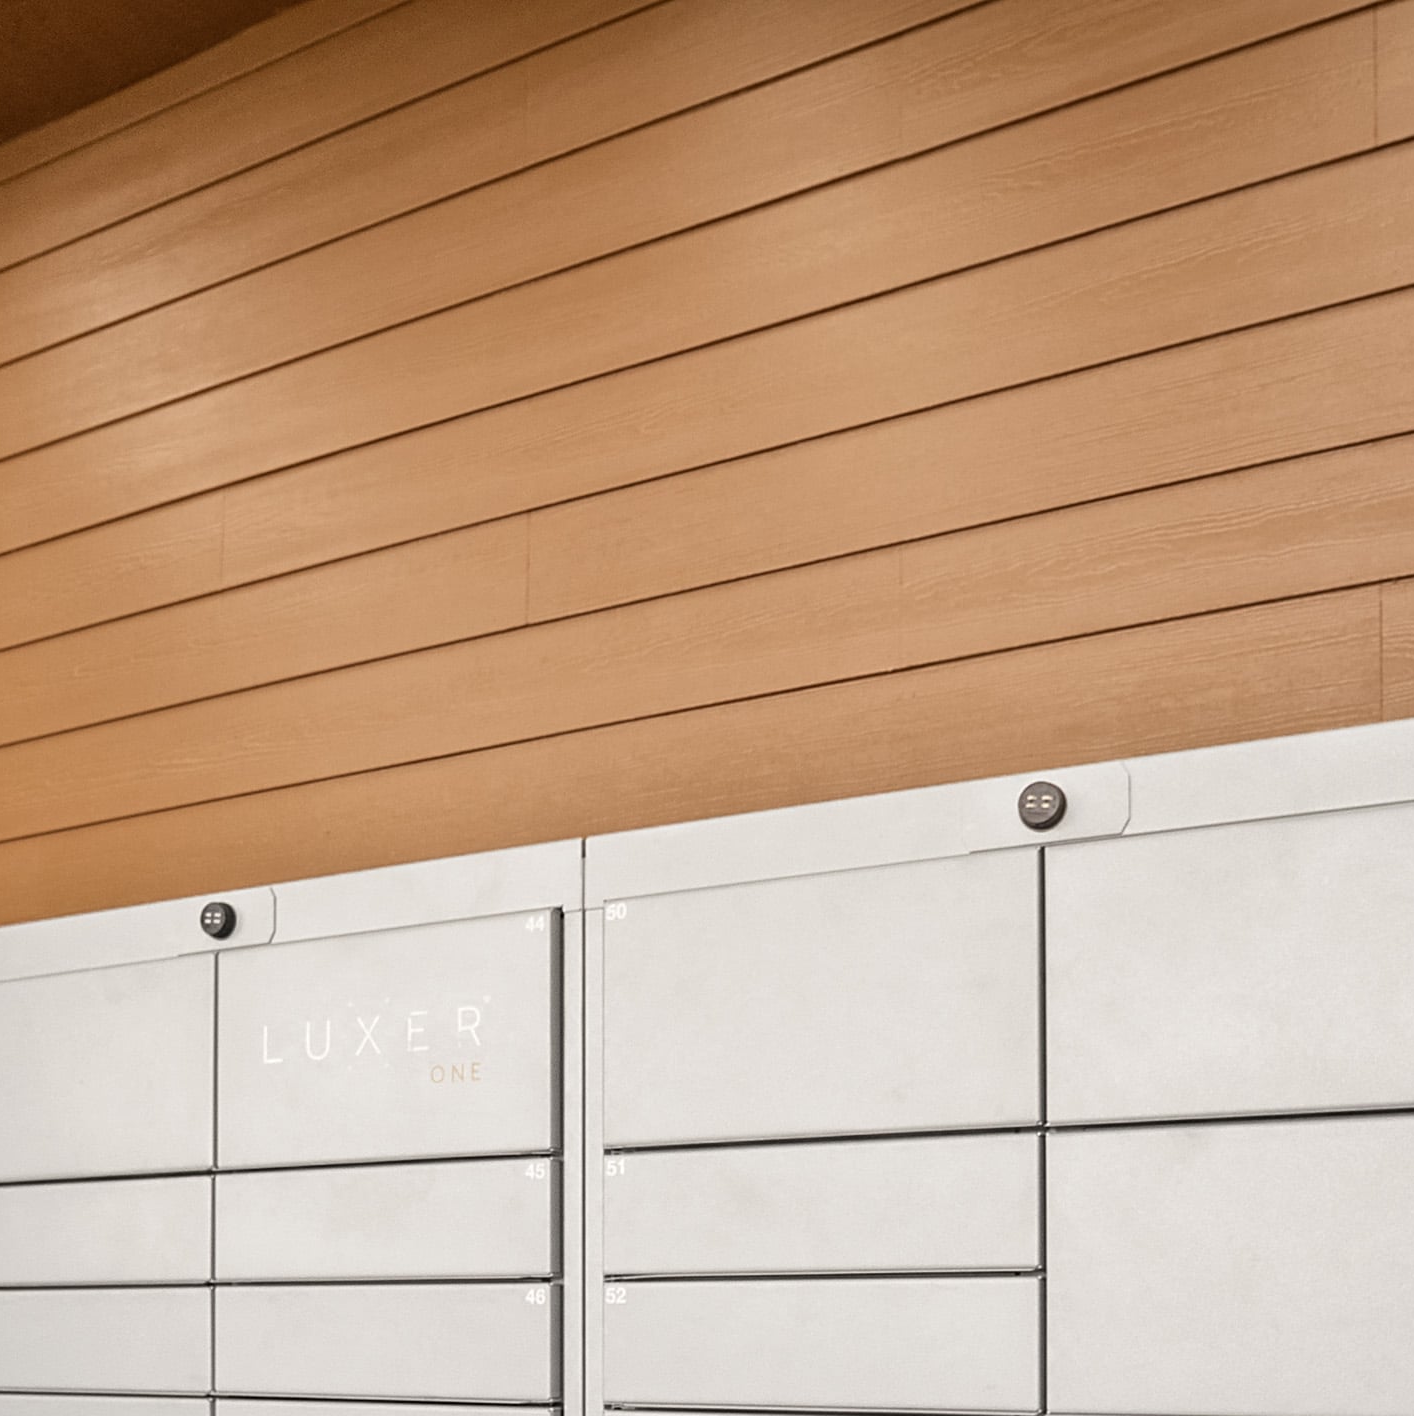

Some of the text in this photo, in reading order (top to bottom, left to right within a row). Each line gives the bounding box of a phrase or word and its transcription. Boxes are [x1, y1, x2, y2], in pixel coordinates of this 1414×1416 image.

[605, 902, 627, 920] 50
[525, 915, 545, 932] 44
[263, 1005, 482, 1064] LUXER
[430, 1062, 483, 1084] ONE
[525, 1163, 545, 1179] 45
[606, 1158, 625, 1176] 51
[525, 1288, 546, 1305] 46
[605, 1287, 627, 1304] 52
